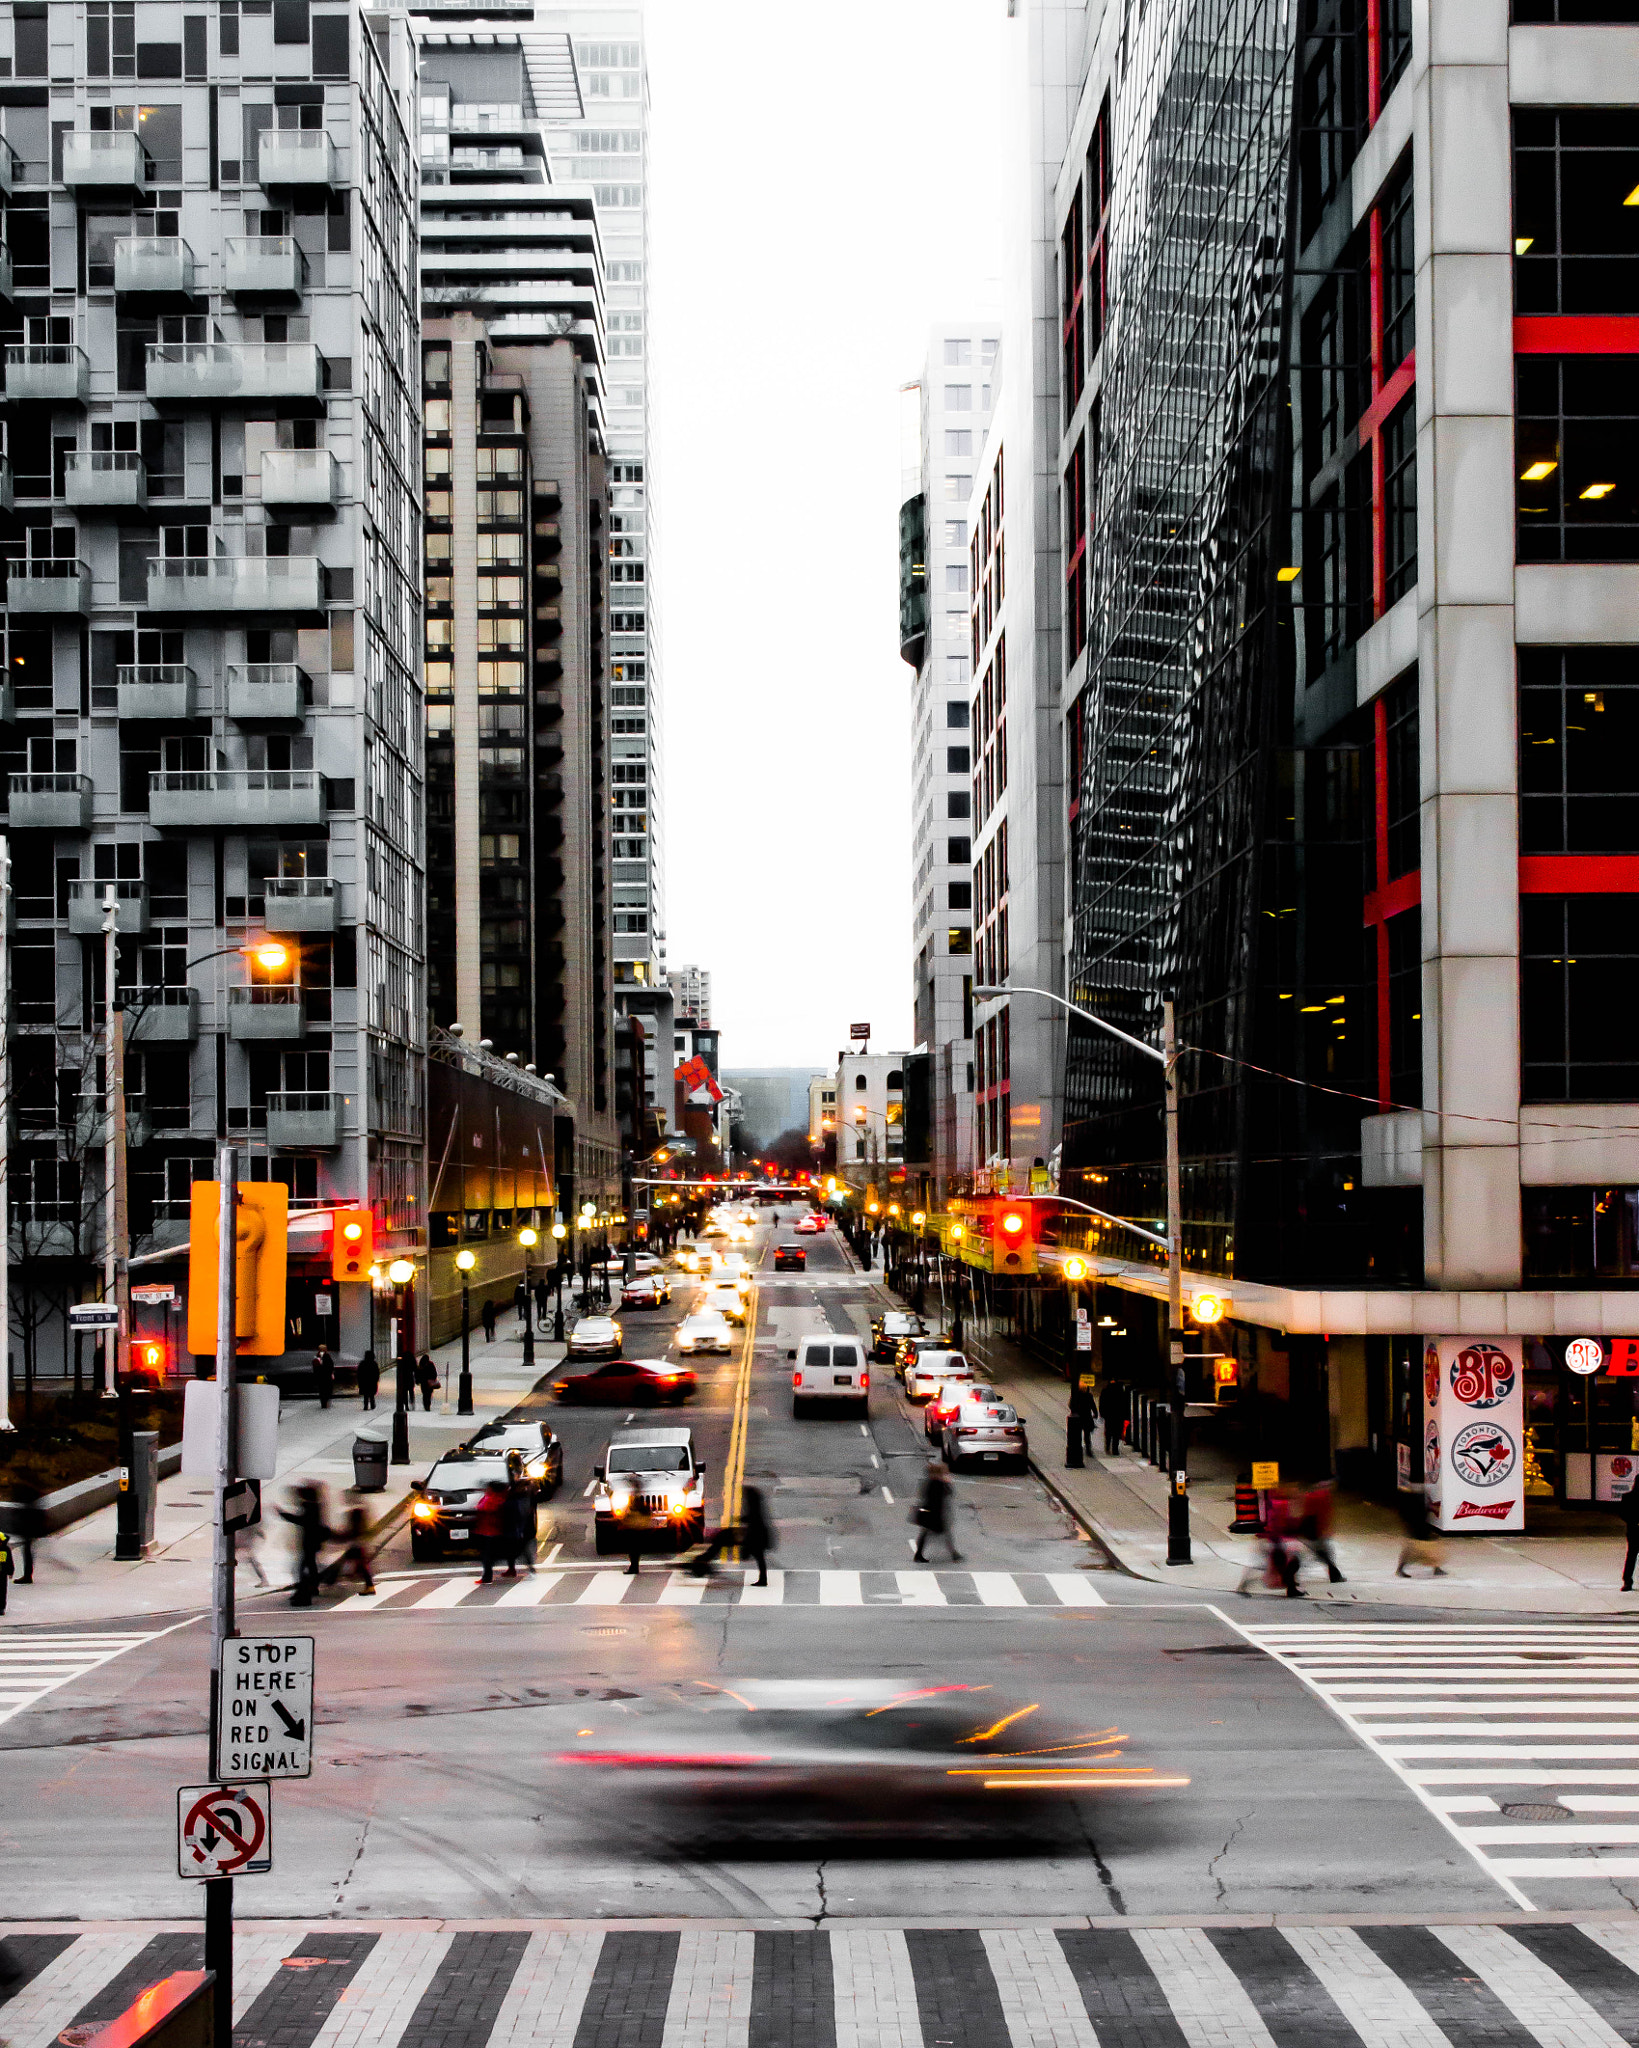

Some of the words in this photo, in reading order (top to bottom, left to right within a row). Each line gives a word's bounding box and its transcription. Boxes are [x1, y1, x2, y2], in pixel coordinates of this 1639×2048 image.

[1569, 1343, 1599, 1369] BP
[1453, 1349, 1514, 1403] BP
[1457, 1426, 1498, 1448] TORONTO
[1457, 1461, 1481, 1483] BLUE
[1486, 1462, 1509, 1483] JAYS
[1456, 1503, 1511, 1516] Budweiser
[238, 1645, 297, 1664] STOP
[236, 1672, 297, 1690] HERE
[232, 1699, 257, 1717] ON
[231, 1725, 269, 1743] RED
[231, 1751, 300, 1771] SIGNAL
